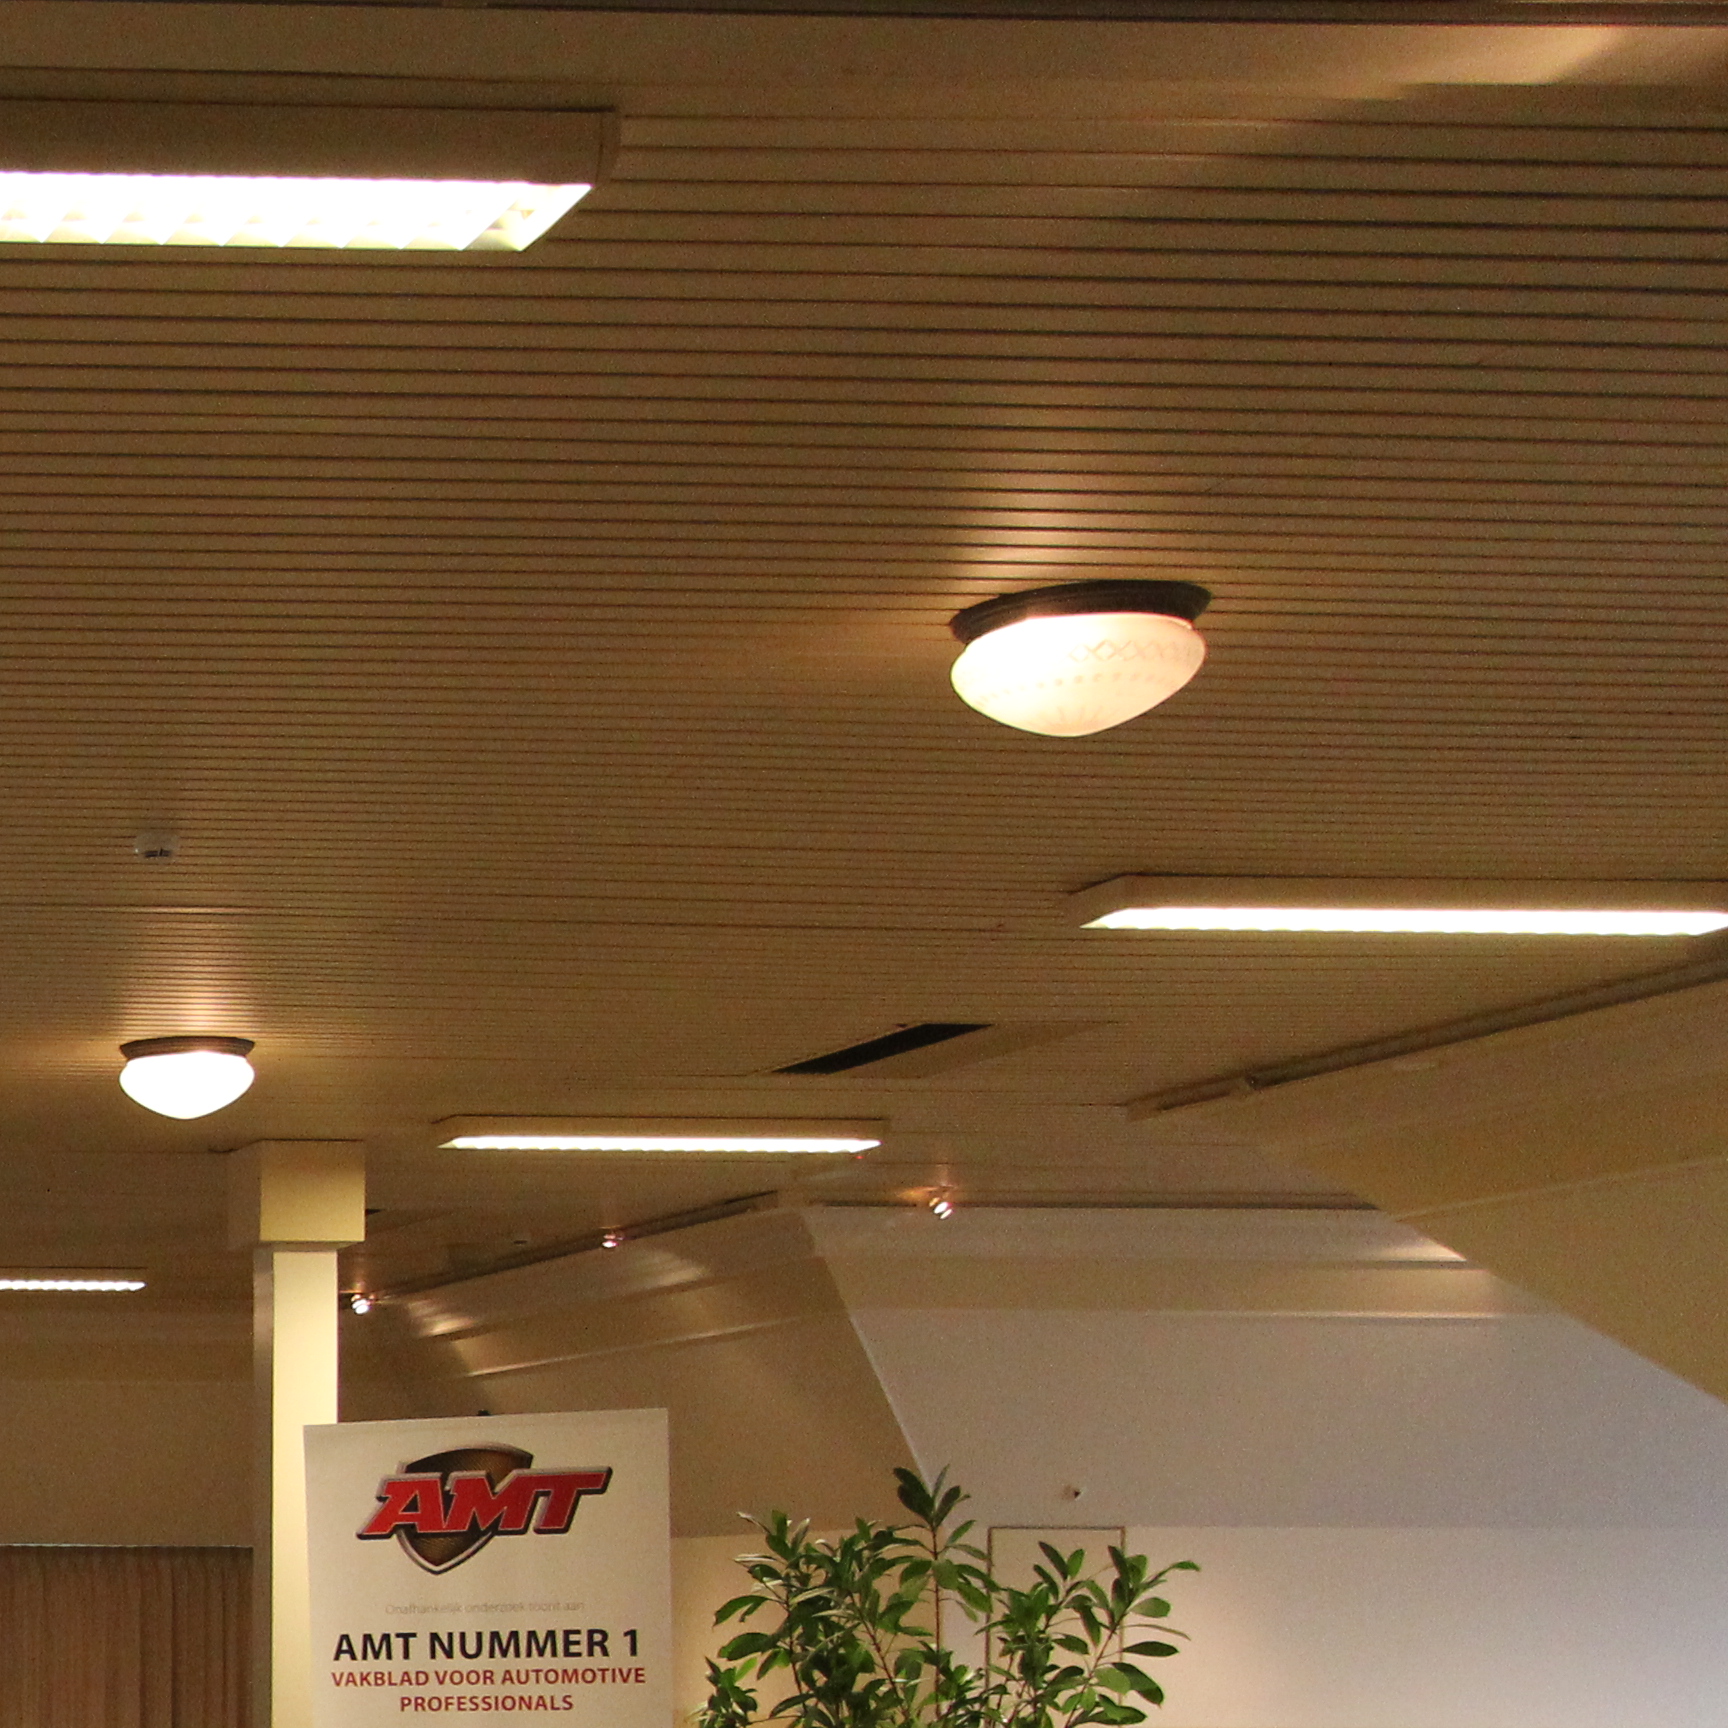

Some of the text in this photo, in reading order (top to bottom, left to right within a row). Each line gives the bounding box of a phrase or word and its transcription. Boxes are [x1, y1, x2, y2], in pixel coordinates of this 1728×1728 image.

[356, 1467, 613, 1540] AMT
[333, 1628, 638, 1662] AMT NUMMER 1
[330, 1666, 647, 1688] VAKBLAD VOOR AUTOMOTIVE
[400, 1694, 574, 1713] PROFESSIONALS
